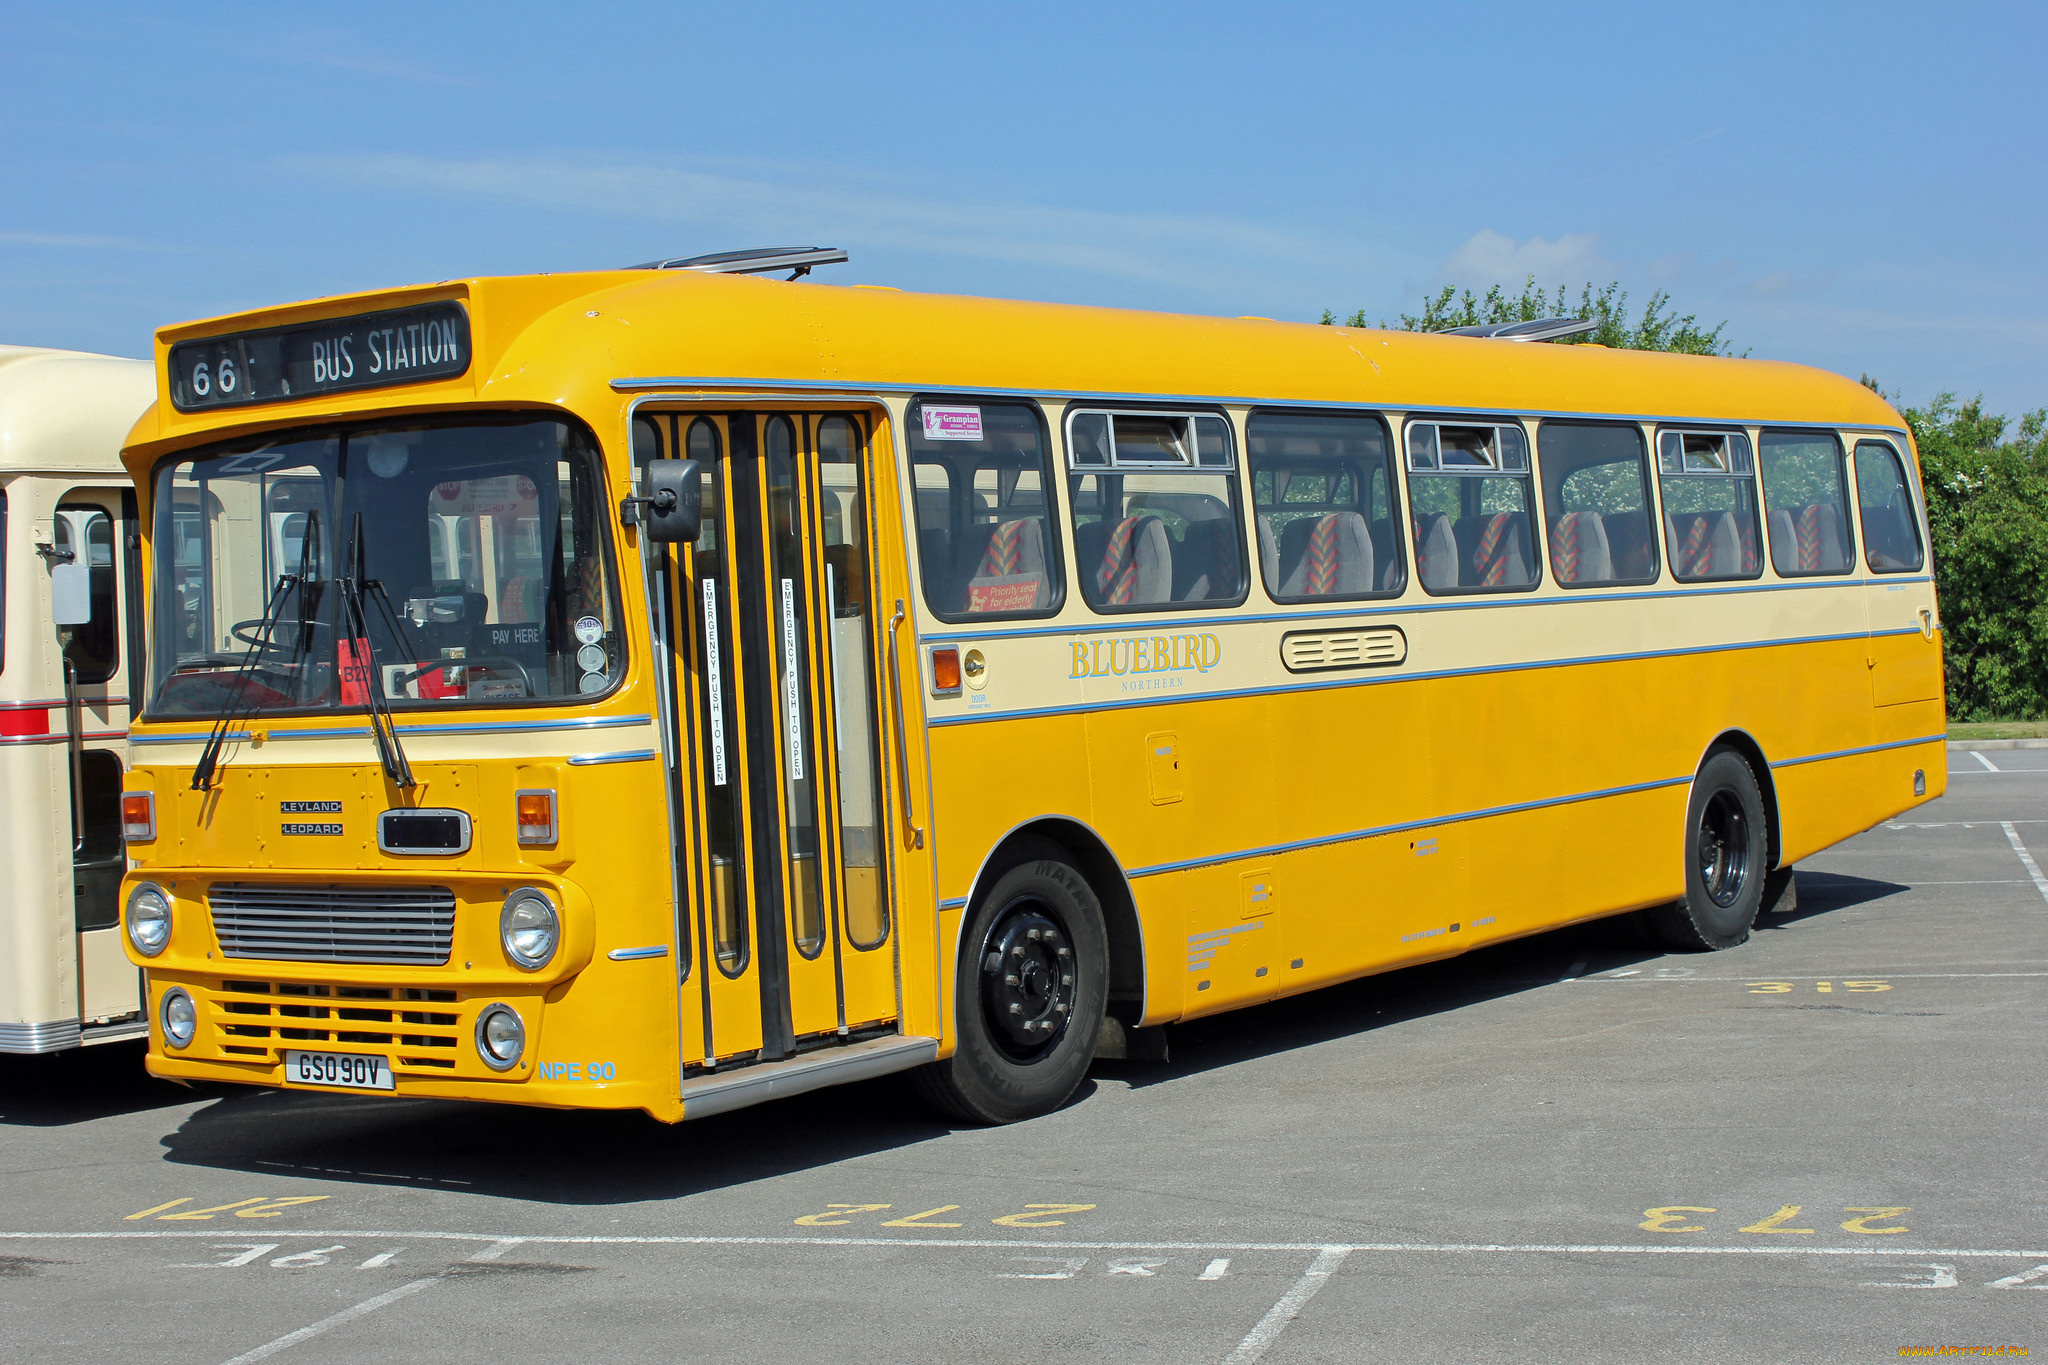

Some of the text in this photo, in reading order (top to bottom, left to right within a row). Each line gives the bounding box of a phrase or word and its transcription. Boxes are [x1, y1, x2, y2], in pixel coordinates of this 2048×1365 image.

[312, 318, 458, 383] BUS STATION
[943, 414, 978, 425] Grampian
[990, 582, 1039, 597] Priority seat
[991, 594, 1033, 607] for elderly
[492, 628, 540, 645] PAY HERE
[1069, 633, 1221, 679] BLUEBIRD
[706, 582, 724, 782] EMERGENCY PUSH TO OPEN
[784, 582, 801, 776] EMERGENCY PUSH TO OPEN
[1122, 677, 1184, 692] NORTHERN
[971, 694, 987, 704] DOOR
[283, 802, 340, 811] LEYLAND
[284, 824, 341, 834] LEOPARD
[1745, 980, 1893, 993] 315
[539, 1061, 616, 1081] NPE 90
